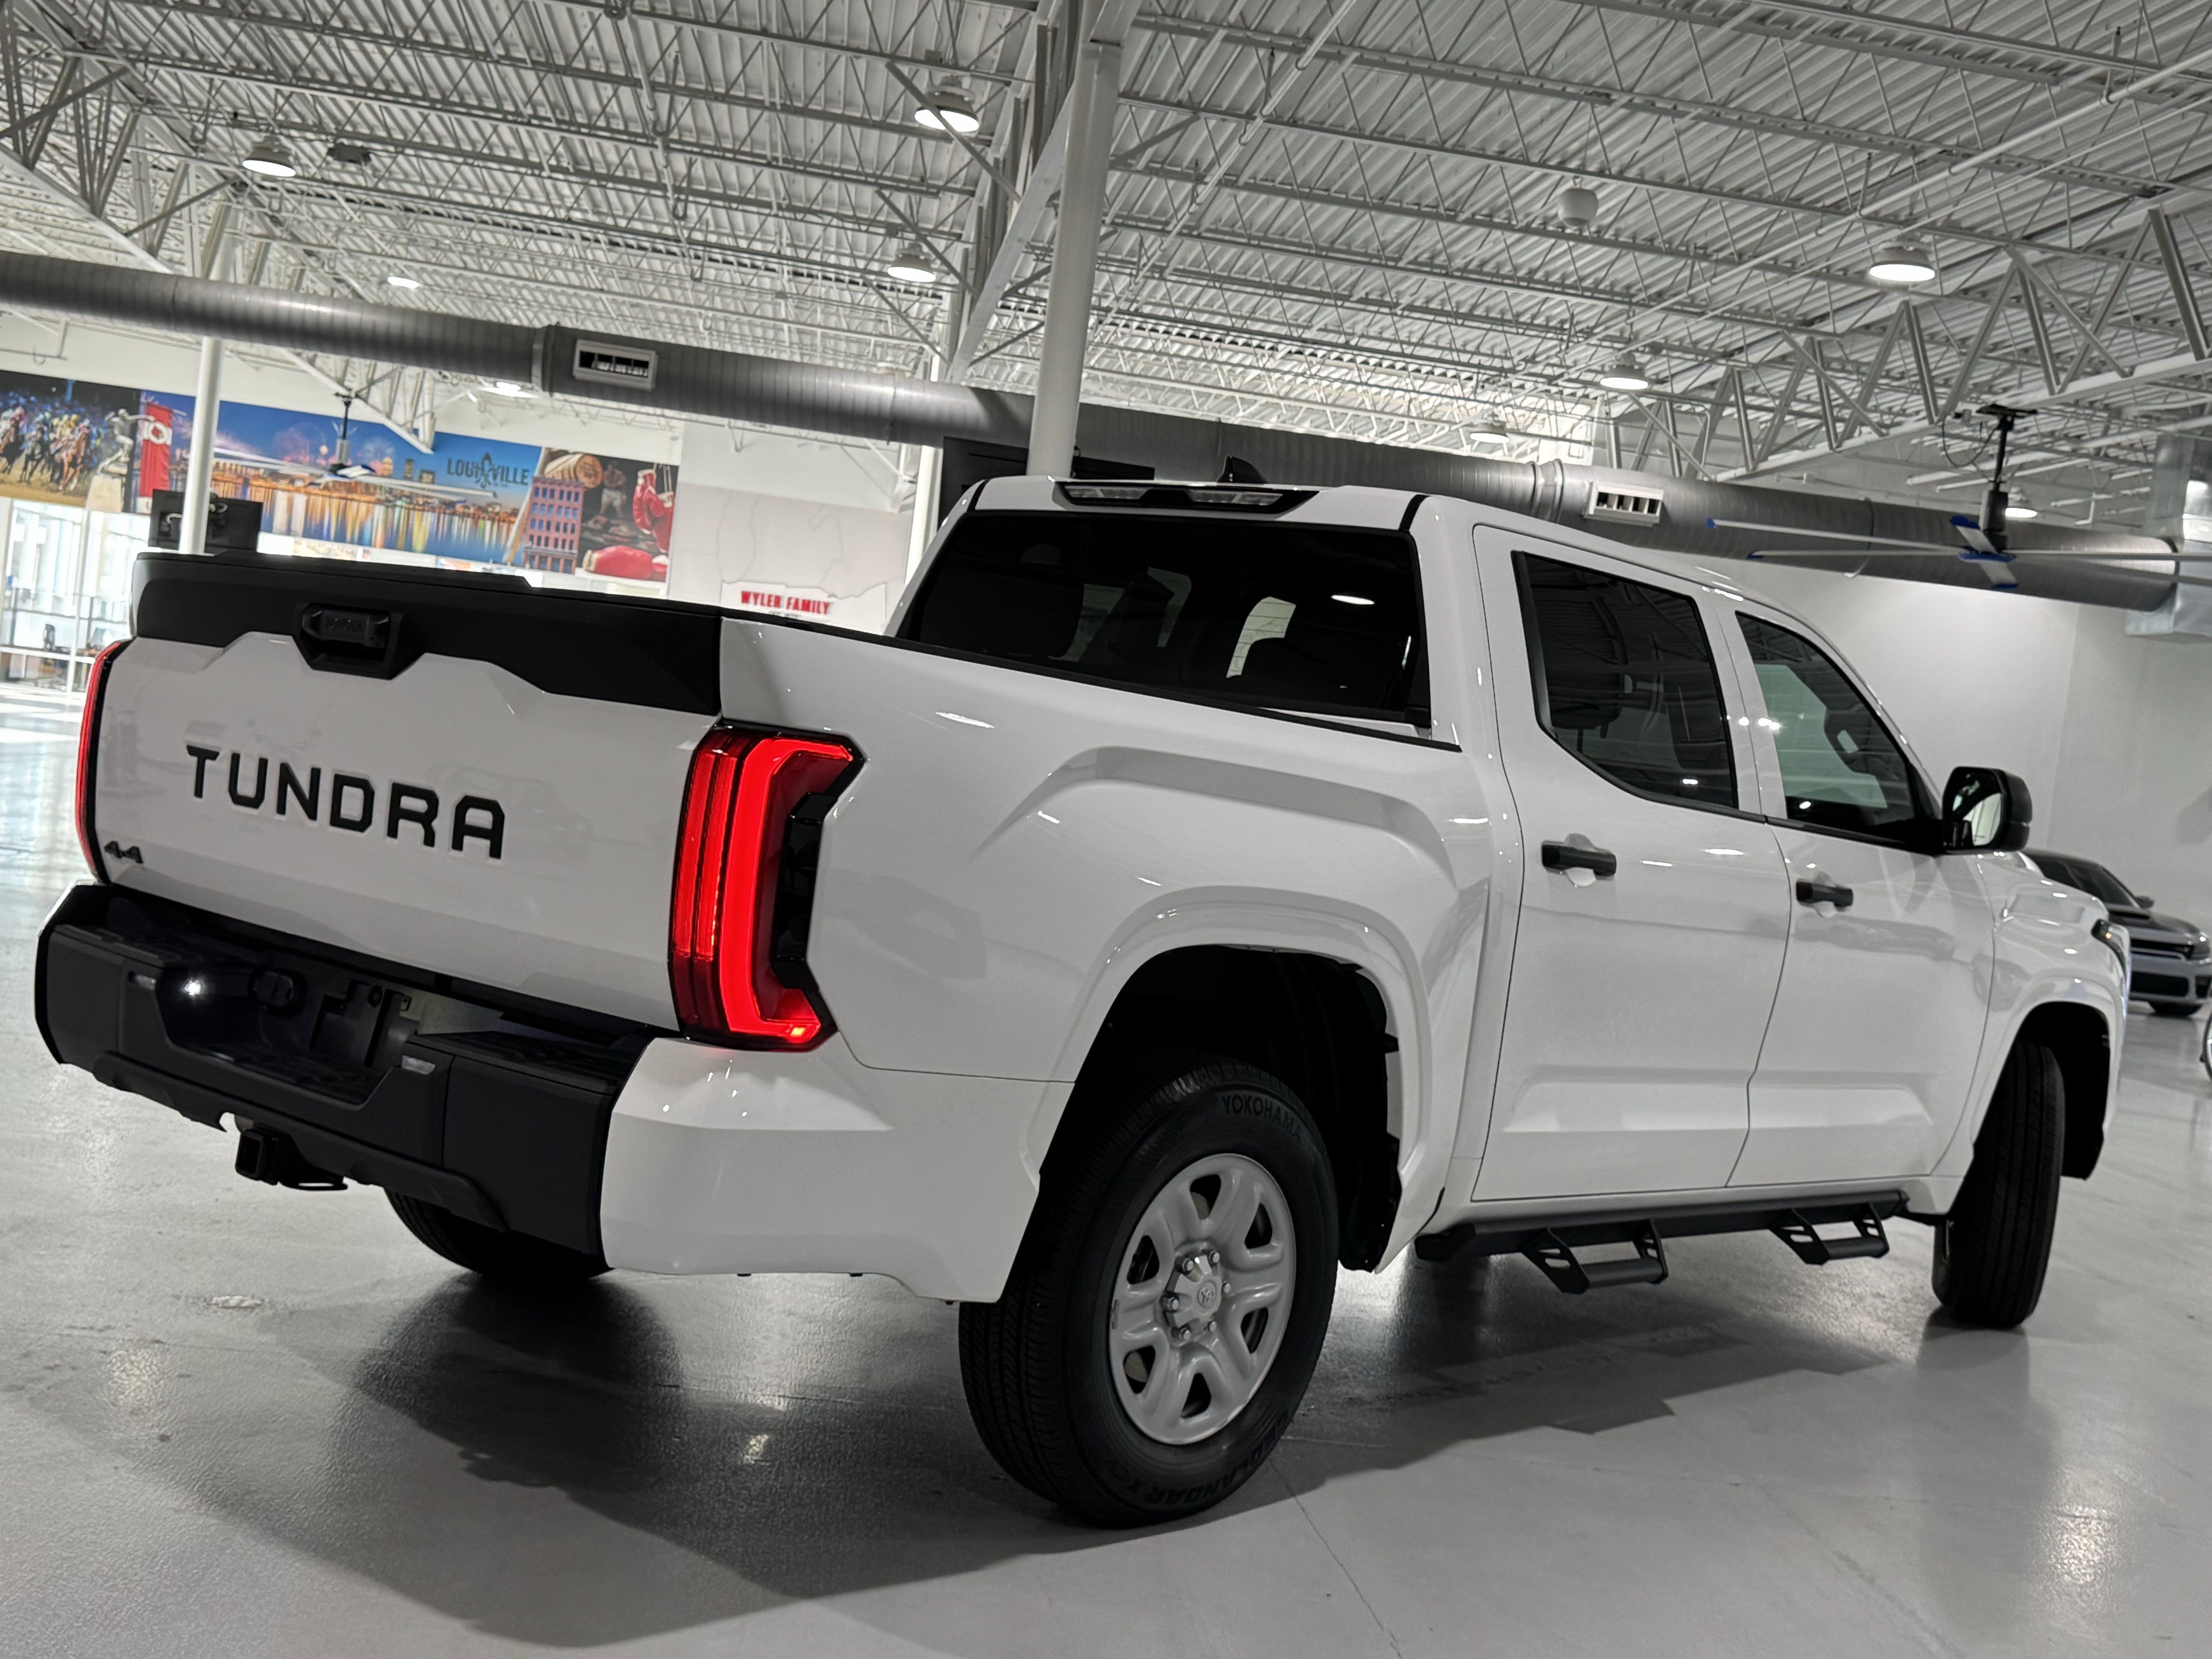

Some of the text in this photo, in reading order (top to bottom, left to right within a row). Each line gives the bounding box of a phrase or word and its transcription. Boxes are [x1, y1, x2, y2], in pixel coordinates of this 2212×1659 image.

[741, 590, 831, 615] WYLER FAMILY
[186, 744, 505, 859] TUNDRA
[1222, 1094, 1301, 1144] YOKOHAMA
